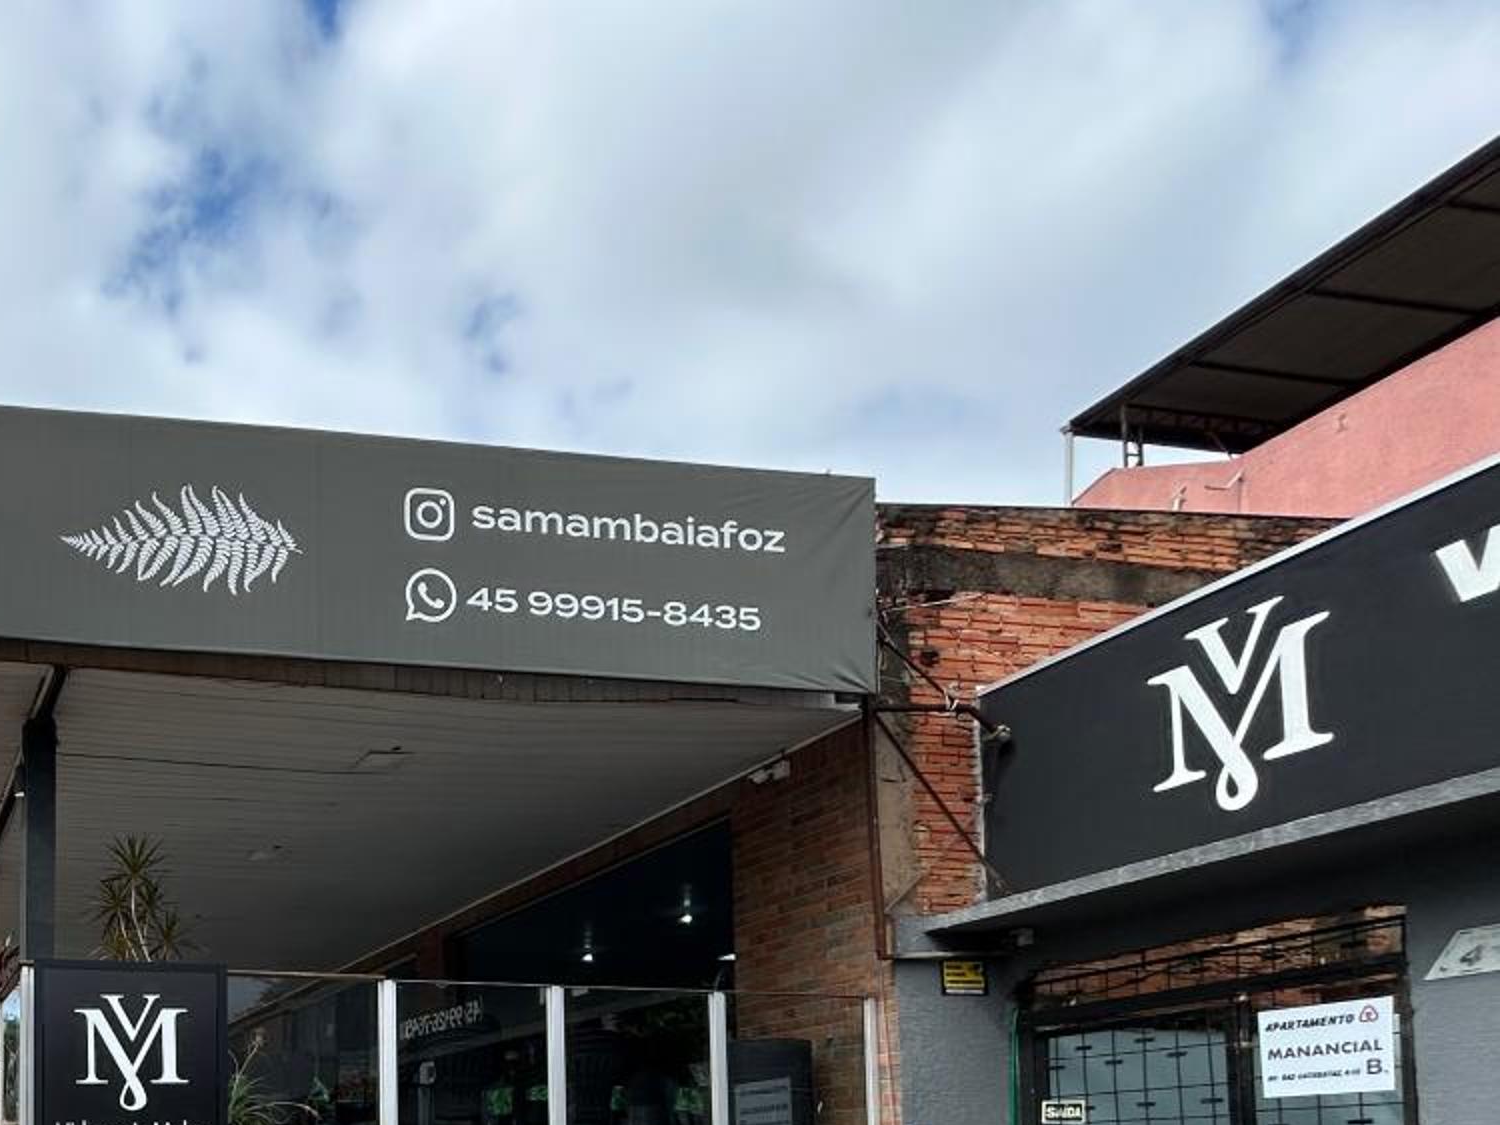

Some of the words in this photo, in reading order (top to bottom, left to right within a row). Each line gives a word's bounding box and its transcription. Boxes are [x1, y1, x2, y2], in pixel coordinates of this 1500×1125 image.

[471, 504, 787, 553] samambaiafoz
[465, 586, 519, 614] 45
[527, 590, 763, 632] 99915-8435
[1265, 1013, 1355, 1033] APARTAMENTO
[1267, 1038, 1384, 1061] MANANCIAL
